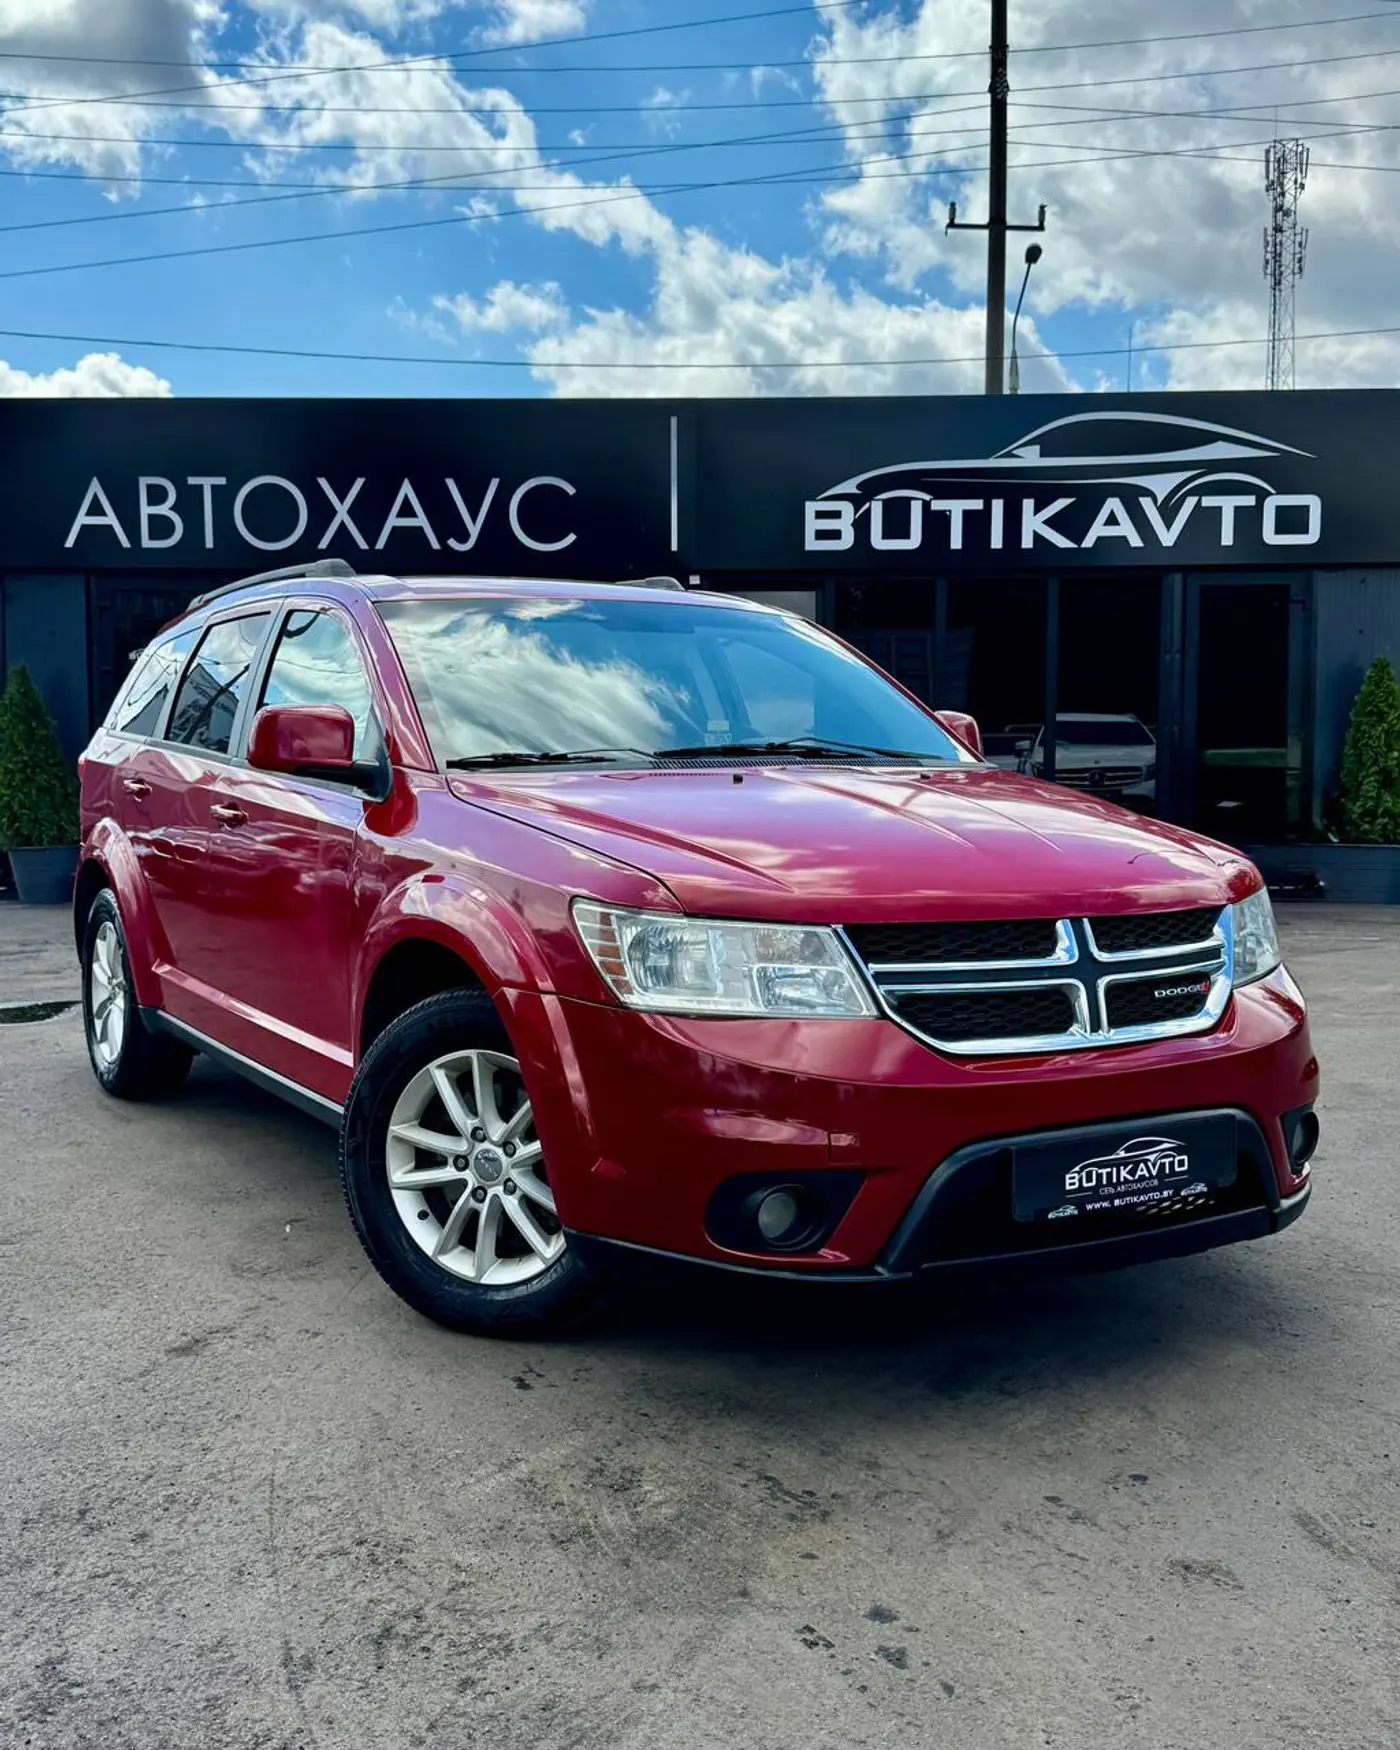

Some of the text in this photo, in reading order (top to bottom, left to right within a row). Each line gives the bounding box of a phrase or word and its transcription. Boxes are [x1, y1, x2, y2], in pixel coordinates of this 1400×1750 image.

[64, 475, 578, 552] АВТОХАУС
[804, 494, 1322, 551] BUTIKAVTO
[1154, 984, 1206, 998] DODGE
[1065, 1155, 1188, 1191] BUTIKAVTO
